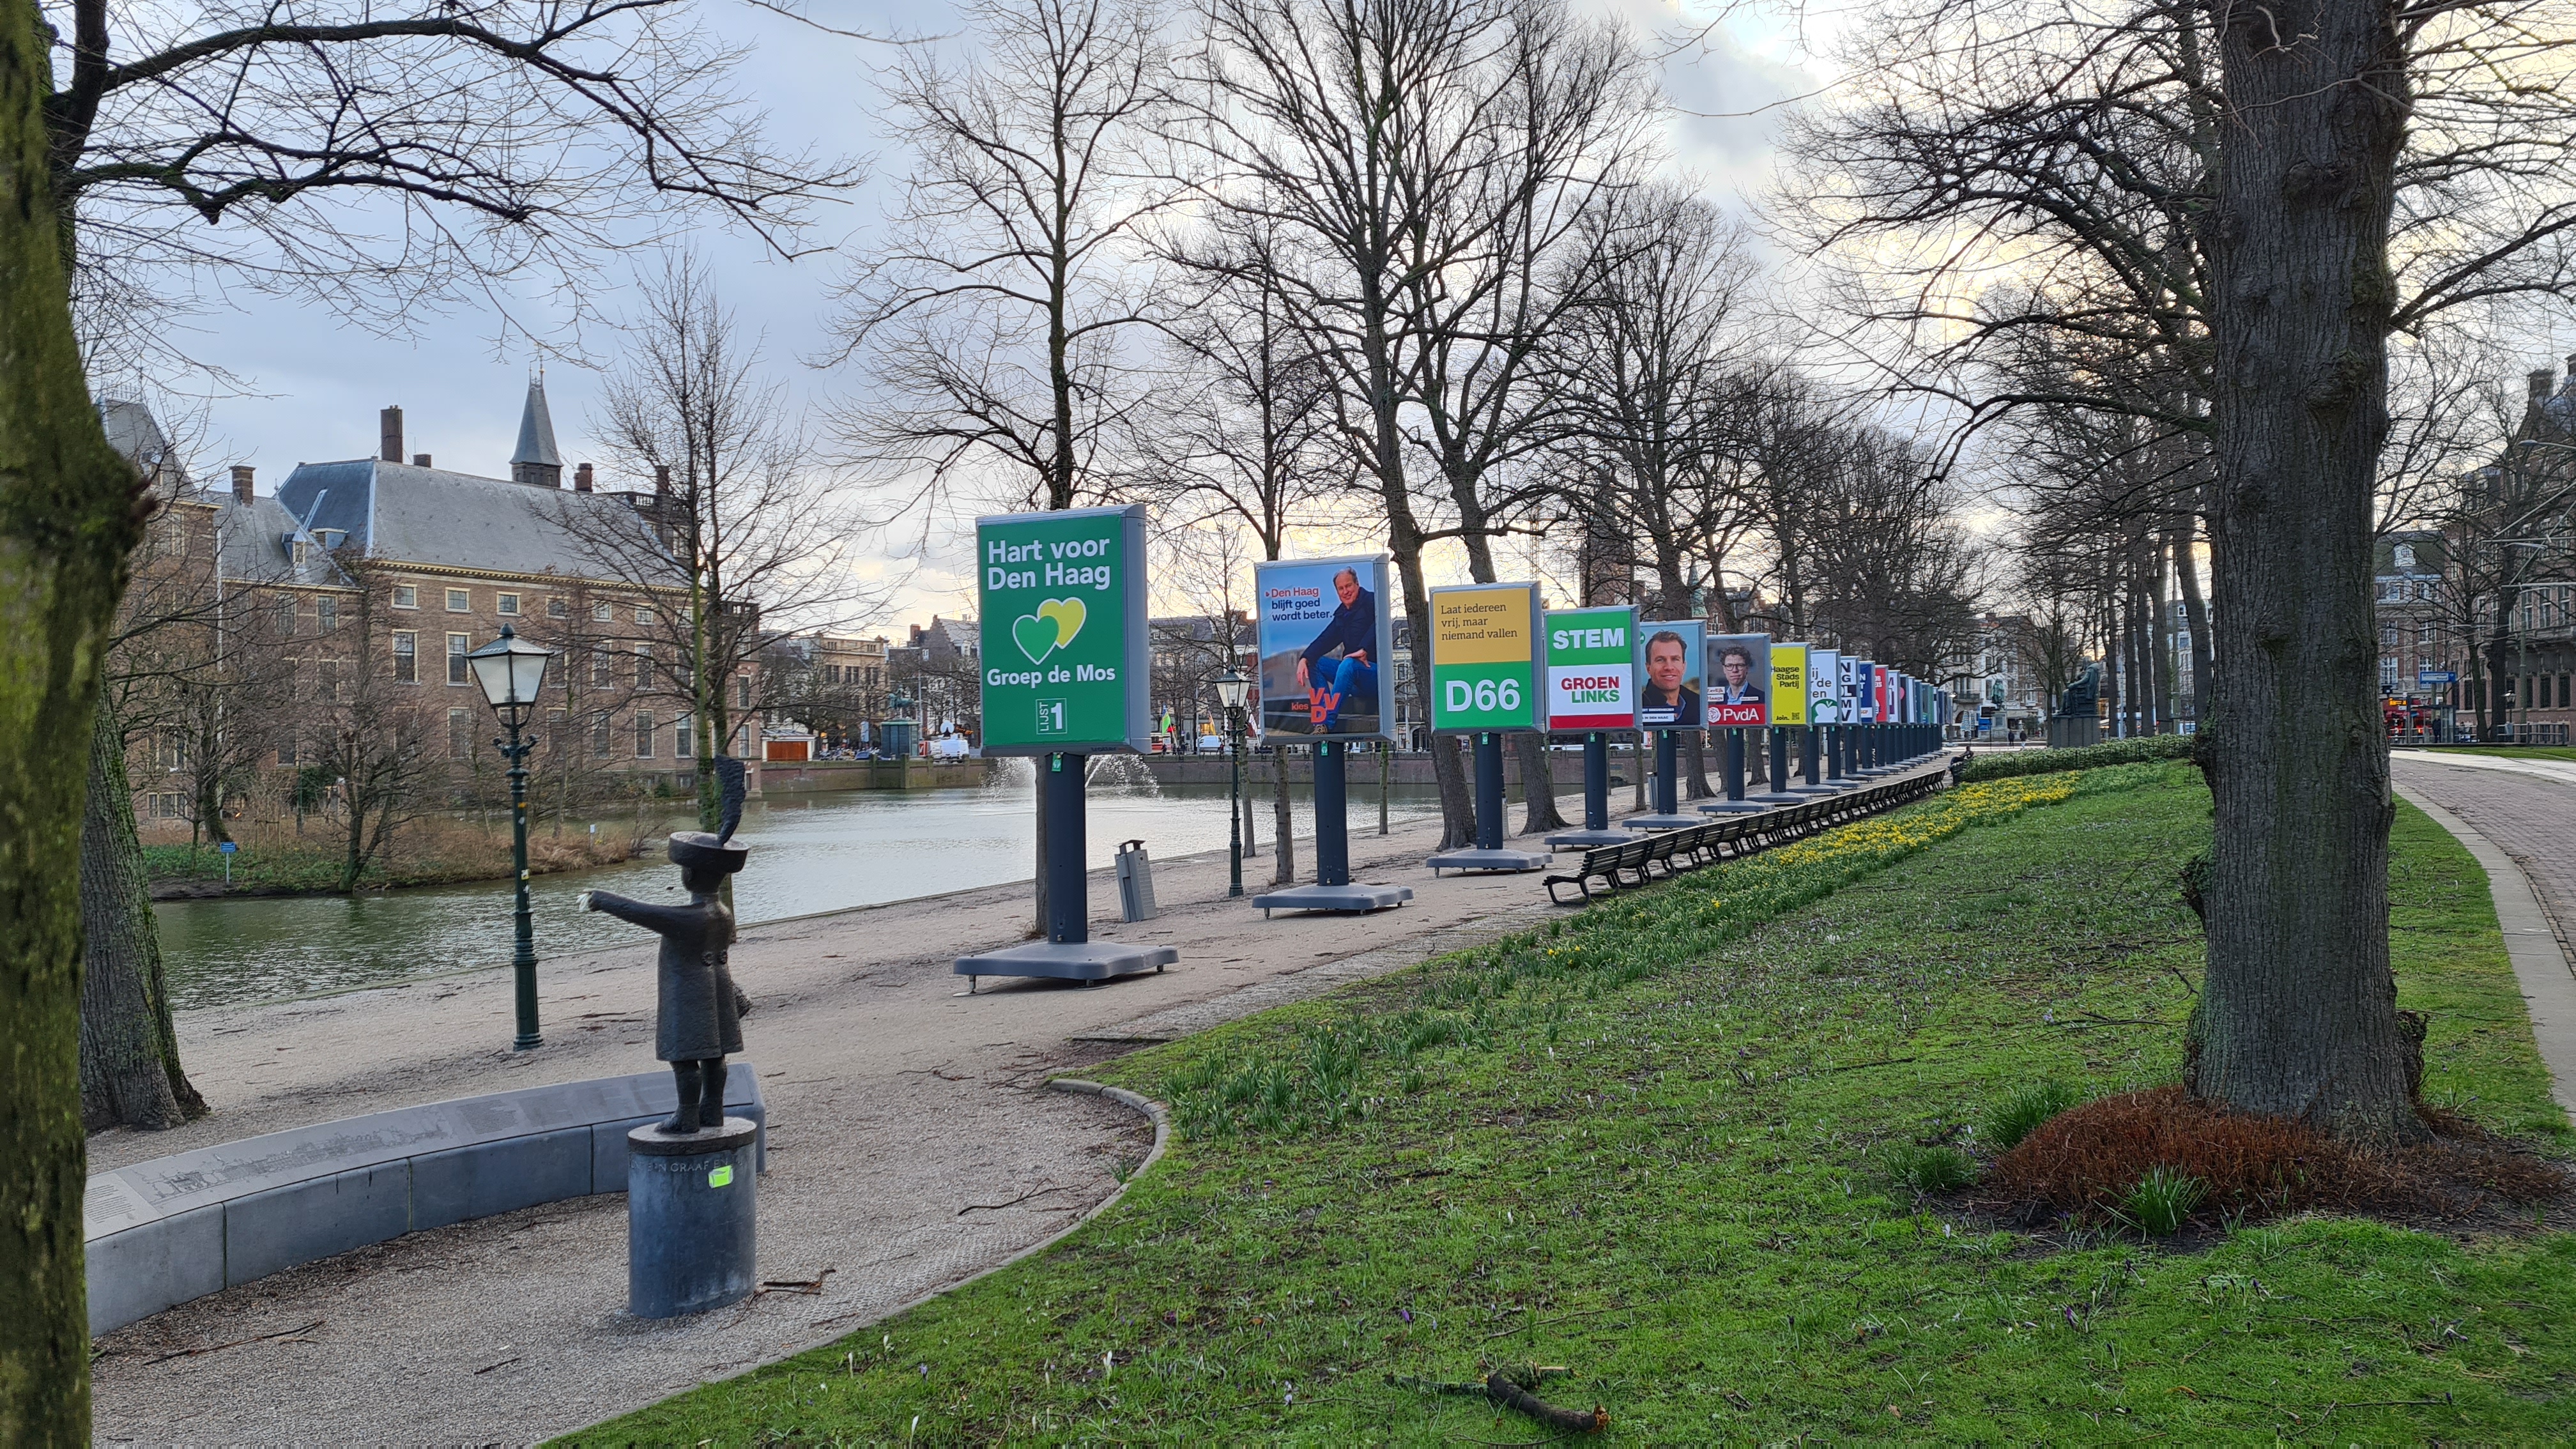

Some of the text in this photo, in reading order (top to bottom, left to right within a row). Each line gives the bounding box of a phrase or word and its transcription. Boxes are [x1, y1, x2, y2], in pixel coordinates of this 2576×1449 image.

[988, 538, 1110, 564] Hart voor
[988, 562, 1110, 590] Den Haag
[1271, 587, 1319, 598] Den Haag
[1271, 597, 1321, 610] blijft goed
[1441, 602, 1506, 615] Laat iedereen
[1271, 610, 1333, 621] wordt beter.
[1441, 618, 1489, 629] vrij, maar
[1441, 628, 1518, 641] niemand vallen
[1552, 627, 1625, 650] STEM
[986, 664, 1116, 689] Groep de Mos
[1771, 666, 1800, 674] Haagse
[1561, 676, 1620, 691] GROEN
[1779, 680, 1800, 689] Partij
[1816, 677, 1832, 687] de
[1446, 678, 1521, 712] D66
[1571, 690, 1620, 703] LINKS
[1039, 702, 1050, 732] LIJST
[1050, 702, 1063, 730] 1
[1724, 708, 1759, 721] PvdA
[670, 1160, 709, 1172] GRAAF
